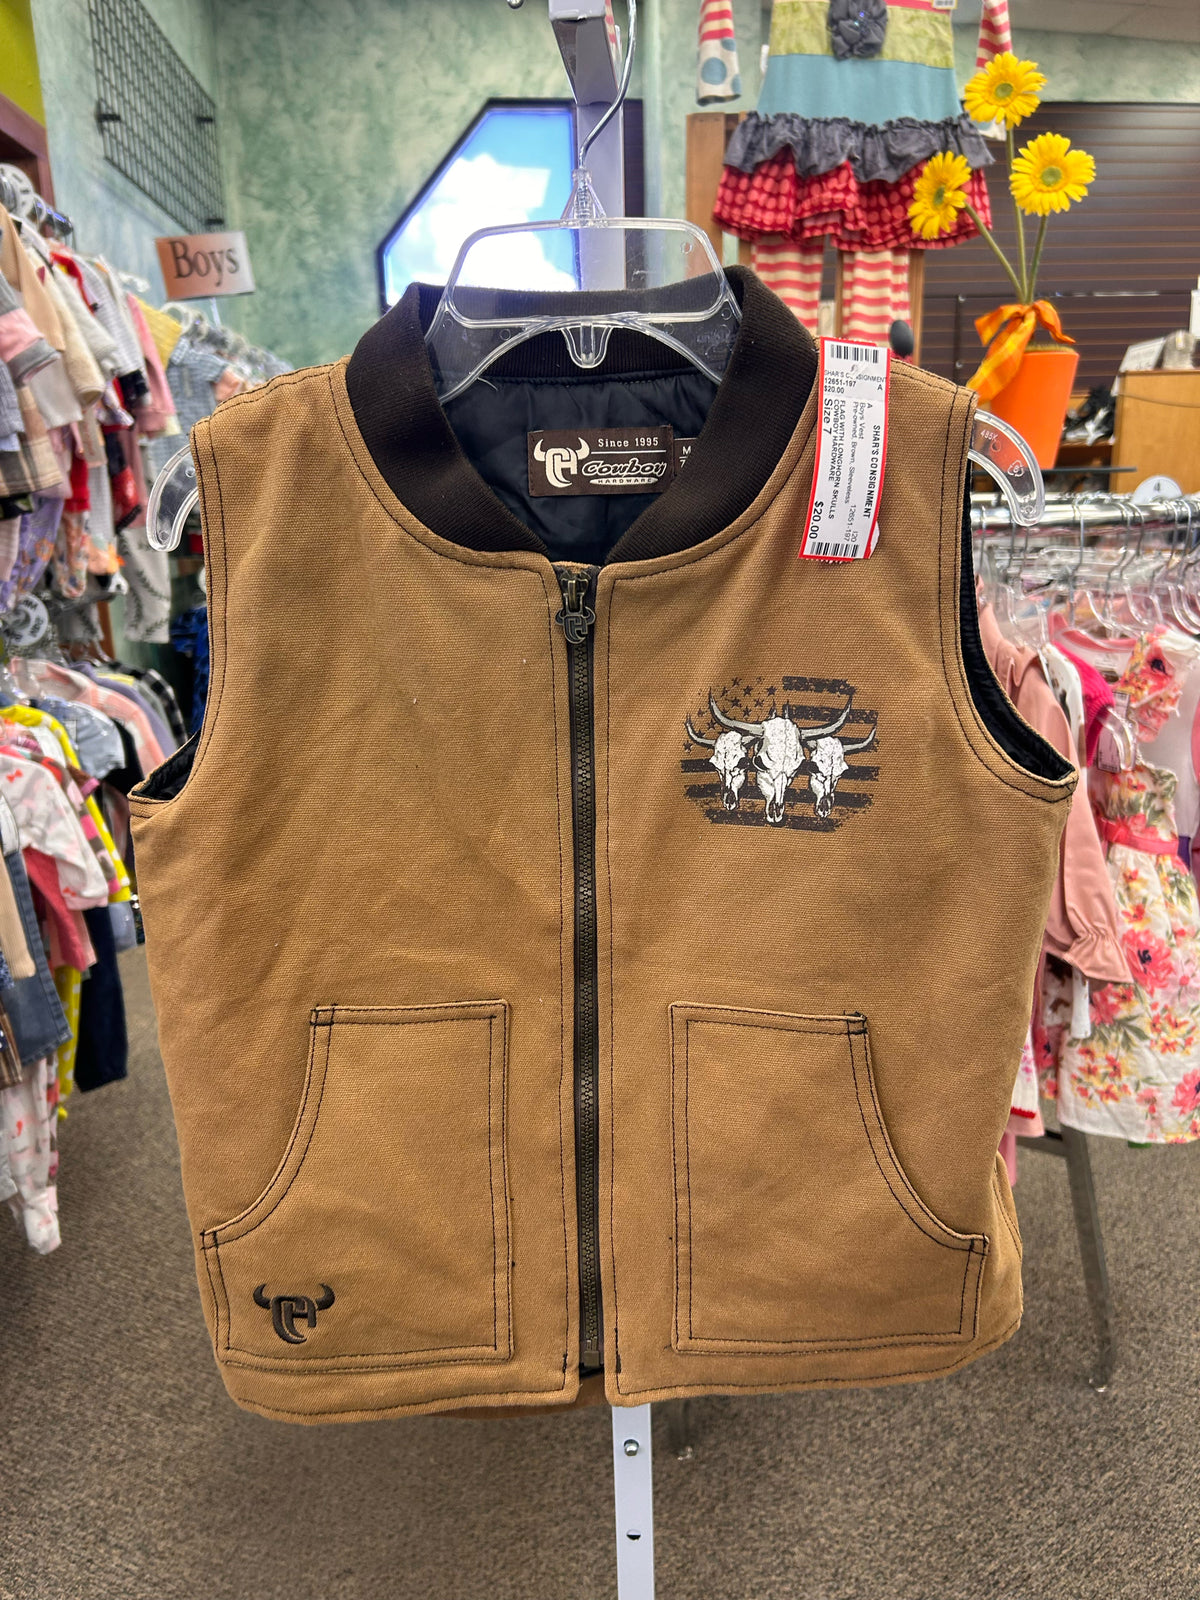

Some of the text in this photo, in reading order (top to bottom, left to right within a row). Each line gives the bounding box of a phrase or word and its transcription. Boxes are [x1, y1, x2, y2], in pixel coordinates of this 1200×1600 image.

[169, 239, 239, 287] Boys
[824, 377, 857, 387] 12651-197
[824, 385, 845, 394] $20.00
[823, 398, 833, 435] Size 7
[597, 437, 659, 448] Since 1995
[828, 399, 840, 481] COWBOY HARDWARE
[849, 441, 858, 464] Brown,
[582, 458, 667, 478] Cowboy
[597, 477, 653, 485] HARDWARE
[833, 441, 844, 487] LONGHORN
[863, 424, 880, 518] SHAR'S CONSIGNMENT
[844, 466, 855, 504] Sleeveless
[808, 500, 824, 539] $20.00
[828, 489, 839, 519] SKULLS
[844, 505, 856, 542] 12651-197
